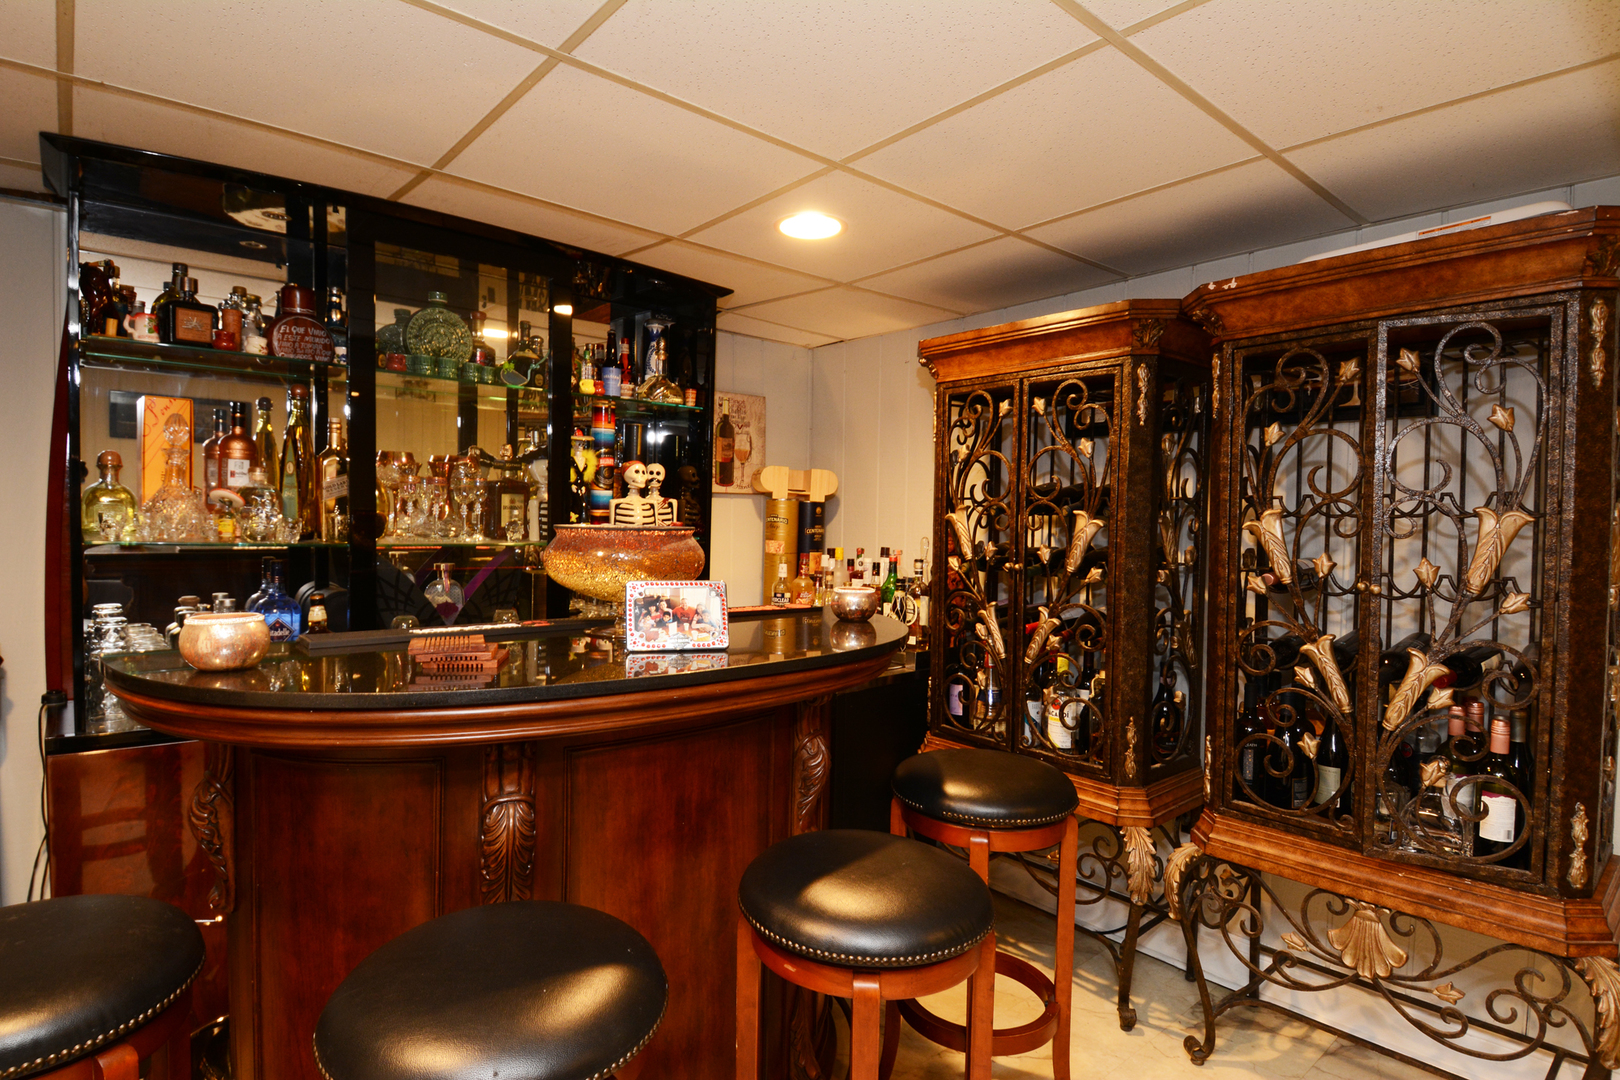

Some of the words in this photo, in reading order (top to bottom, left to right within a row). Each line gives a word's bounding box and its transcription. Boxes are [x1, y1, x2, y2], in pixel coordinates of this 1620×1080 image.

[291, 326, 306, 335] QUE
[308, 327, 327, 337] VINO
[283, 334, 302, 342] ESTE
[304, 336, 331, 344] MUNDO
